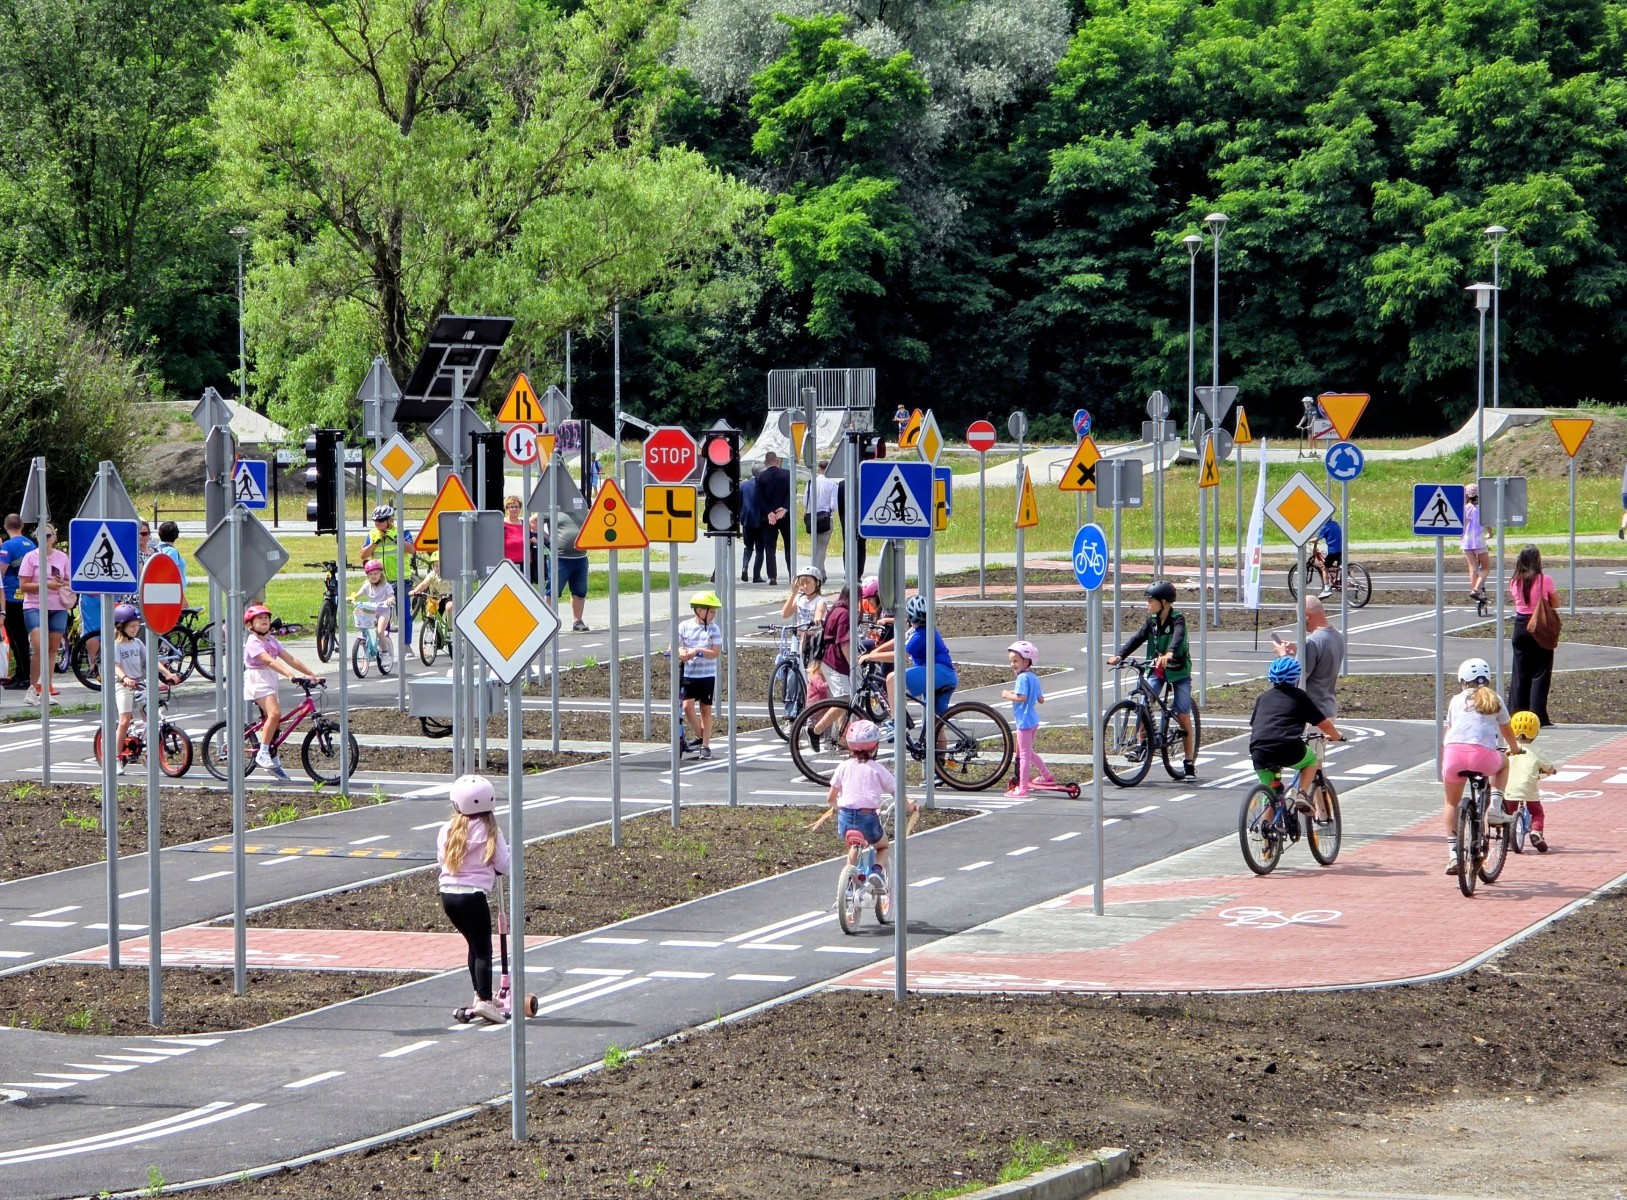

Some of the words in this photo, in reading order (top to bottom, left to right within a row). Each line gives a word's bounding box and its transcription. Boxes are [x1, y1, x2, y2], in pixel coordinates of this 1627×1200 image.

[650, 447, 691, 464] STOP
[121, 651, 129, 660] ES
[130, 649, 140, 657] PLE
